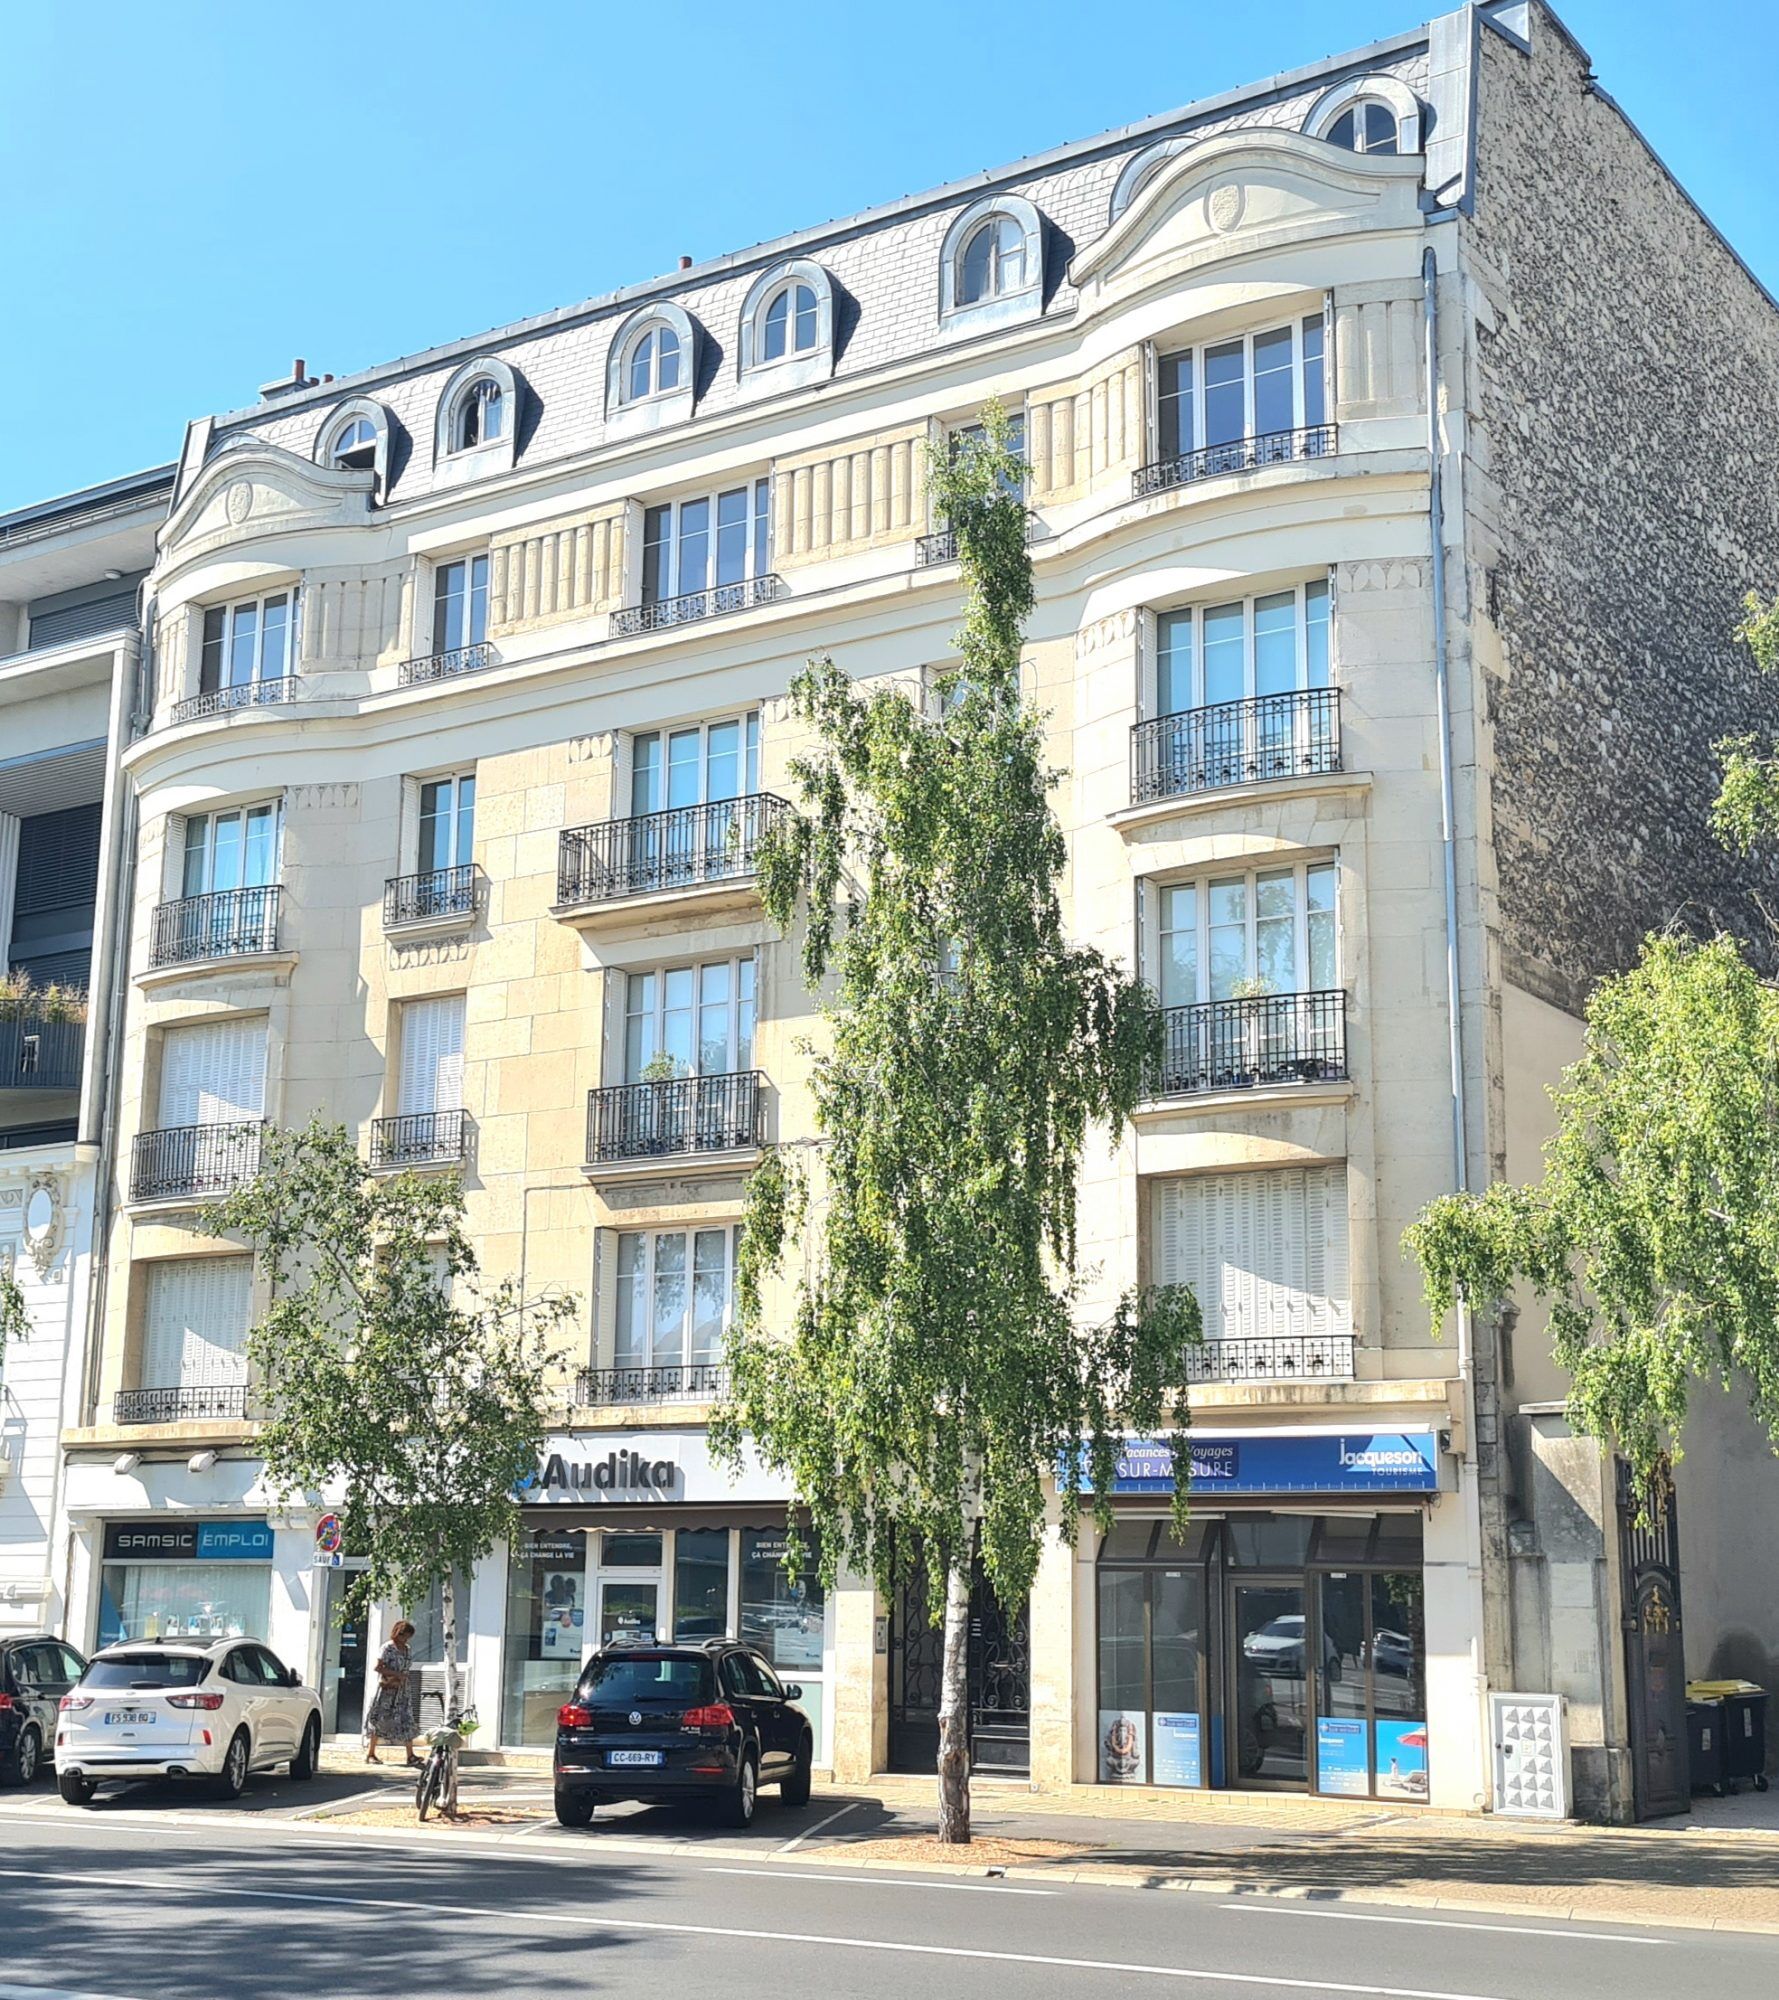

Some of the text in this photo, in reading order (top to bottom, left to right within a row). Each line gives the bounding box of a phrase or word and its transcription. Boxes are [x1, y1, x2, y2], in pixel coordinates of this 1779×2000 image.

[541, 1449, 674, 1490] Audika
[1118, 1461, 1233, 1478] SUR-MSURE
[1371, 1467, 1423, 1476] TOURISME
[118, 1534, 269, 1547] SAMSIC EMPLOI
[313, 1555, 330, 1564] SAUF
[555, 1551, 563, 1559] LA
[564, 1551, 575, 1559] VIE
[751, 1551, 761, 1560] ÇA
